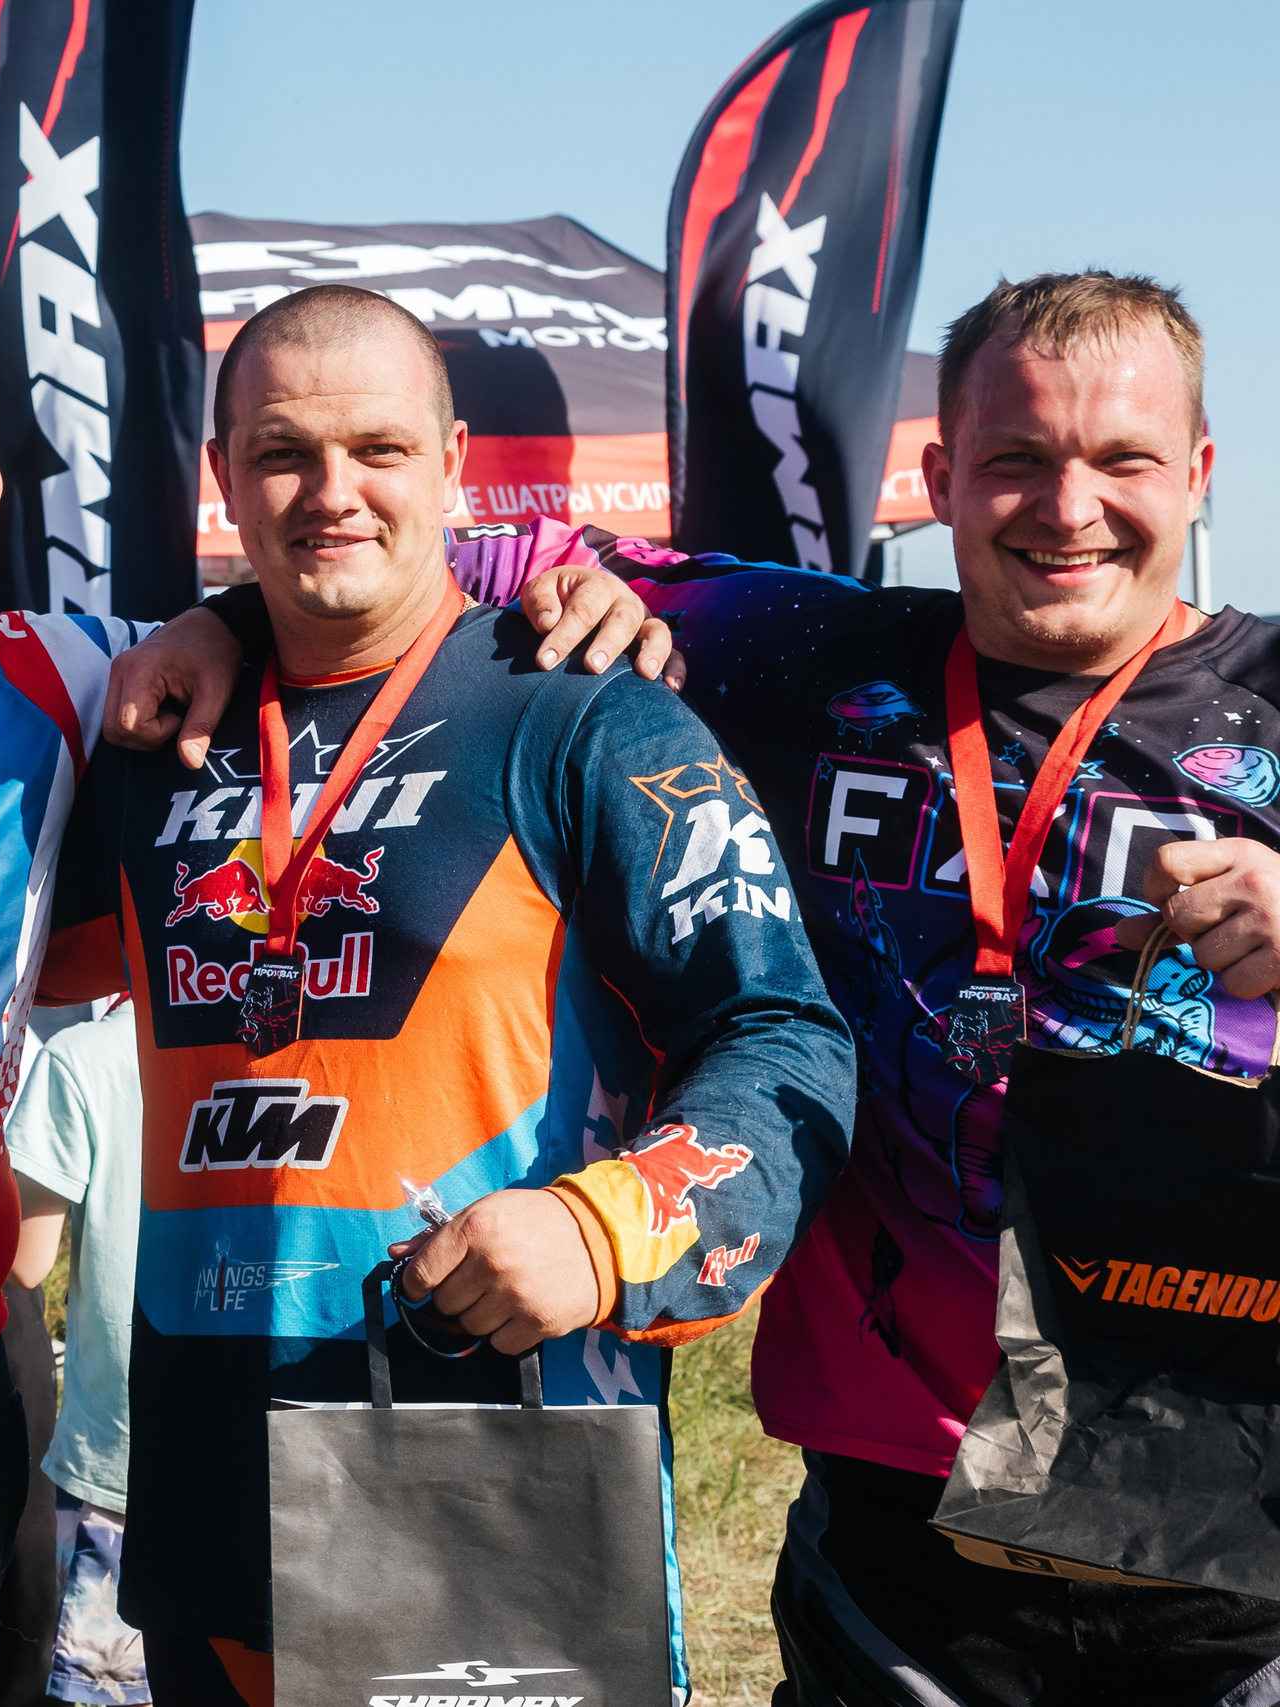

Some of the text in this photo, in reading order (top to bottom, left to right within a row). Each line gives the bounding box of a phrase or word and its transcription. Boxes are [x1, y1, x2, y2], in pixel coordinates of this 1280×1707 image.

[487, 481, 594, 517] ШАТРЫ
[154, 771, 448, 847] KINI
[668, 876, 803, 946] KIN
[253, 967, 300, 980] ПРОХВАТ
[294, 931, 374, 1000] ull
[958, 989, 1020, 1003] ПРОХВАТ
[181, 1082, 346, 1169] KTM
[1101, 1258, 1280, 1324] TAGENDU
